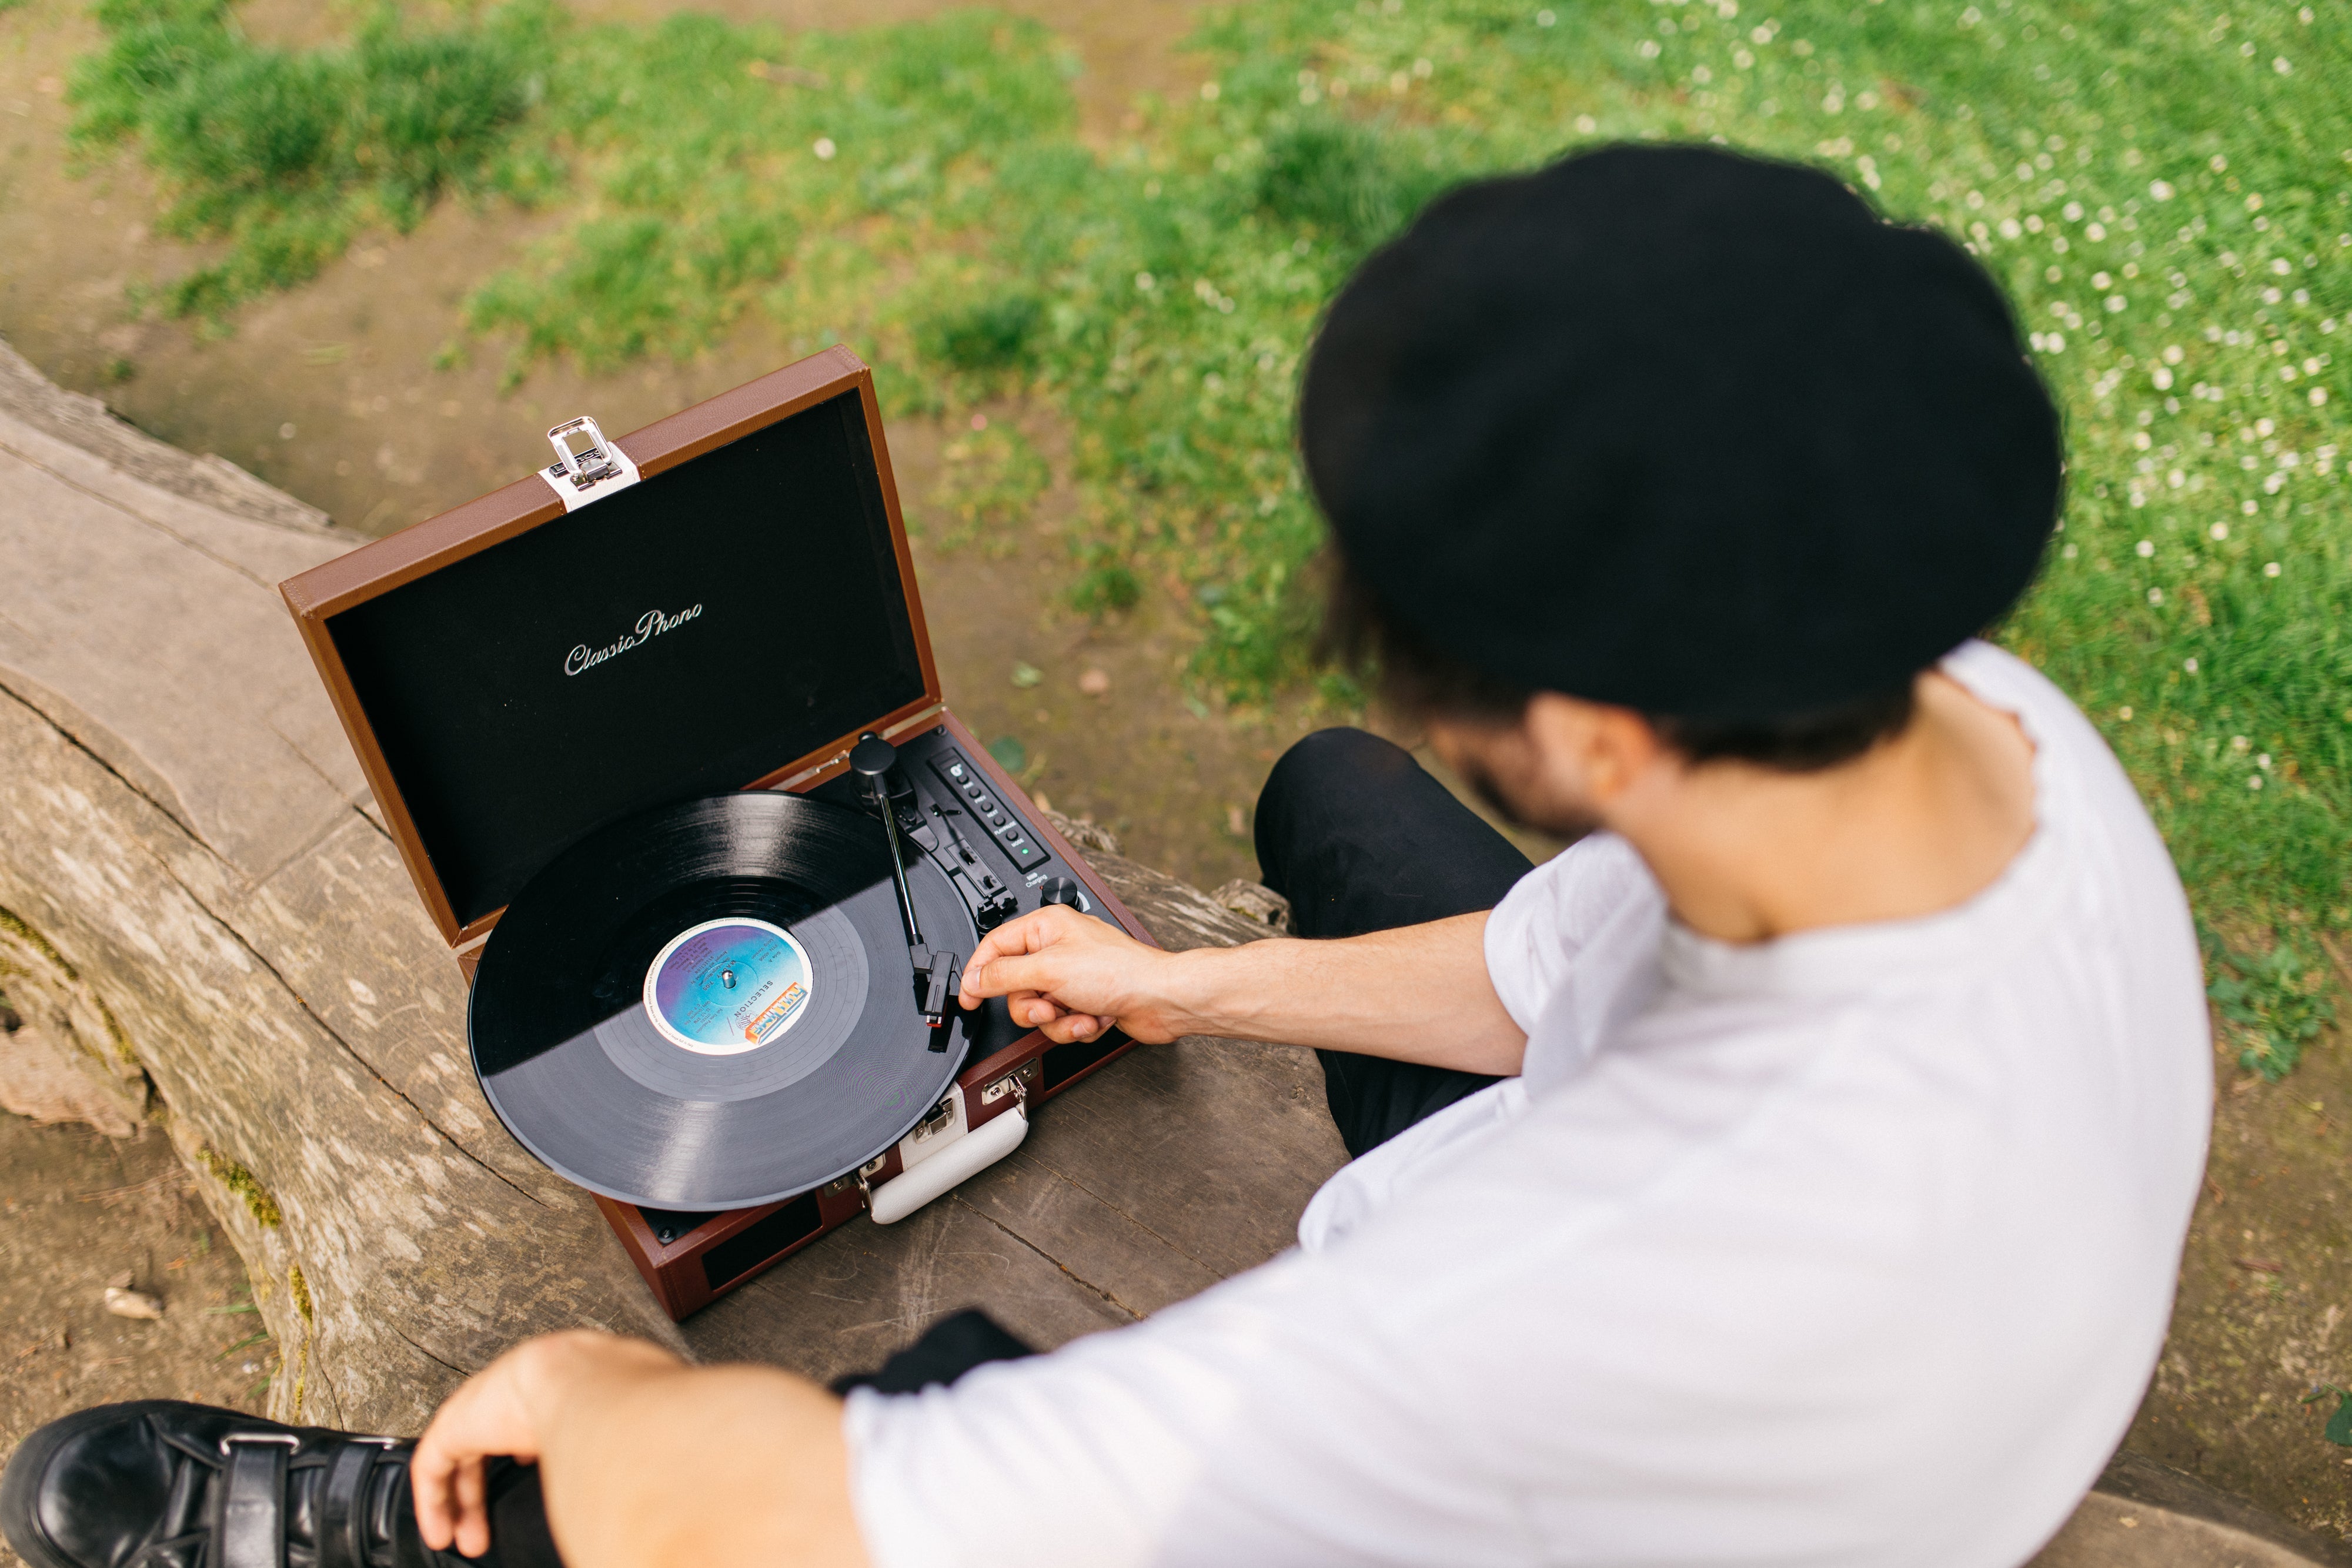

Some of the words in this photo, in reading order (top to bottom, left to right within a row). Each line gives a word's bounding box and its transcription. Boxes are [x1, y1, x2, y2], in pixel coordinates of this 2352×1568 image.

[987, 810, 998, 818] NEXT
[1011, 838, 1024, 847] MODE
[1025, 874, 1047, 888] Charging
[701, 981, 714, 991] 7:05
[733, 981, 773, 1017] SELECTION
